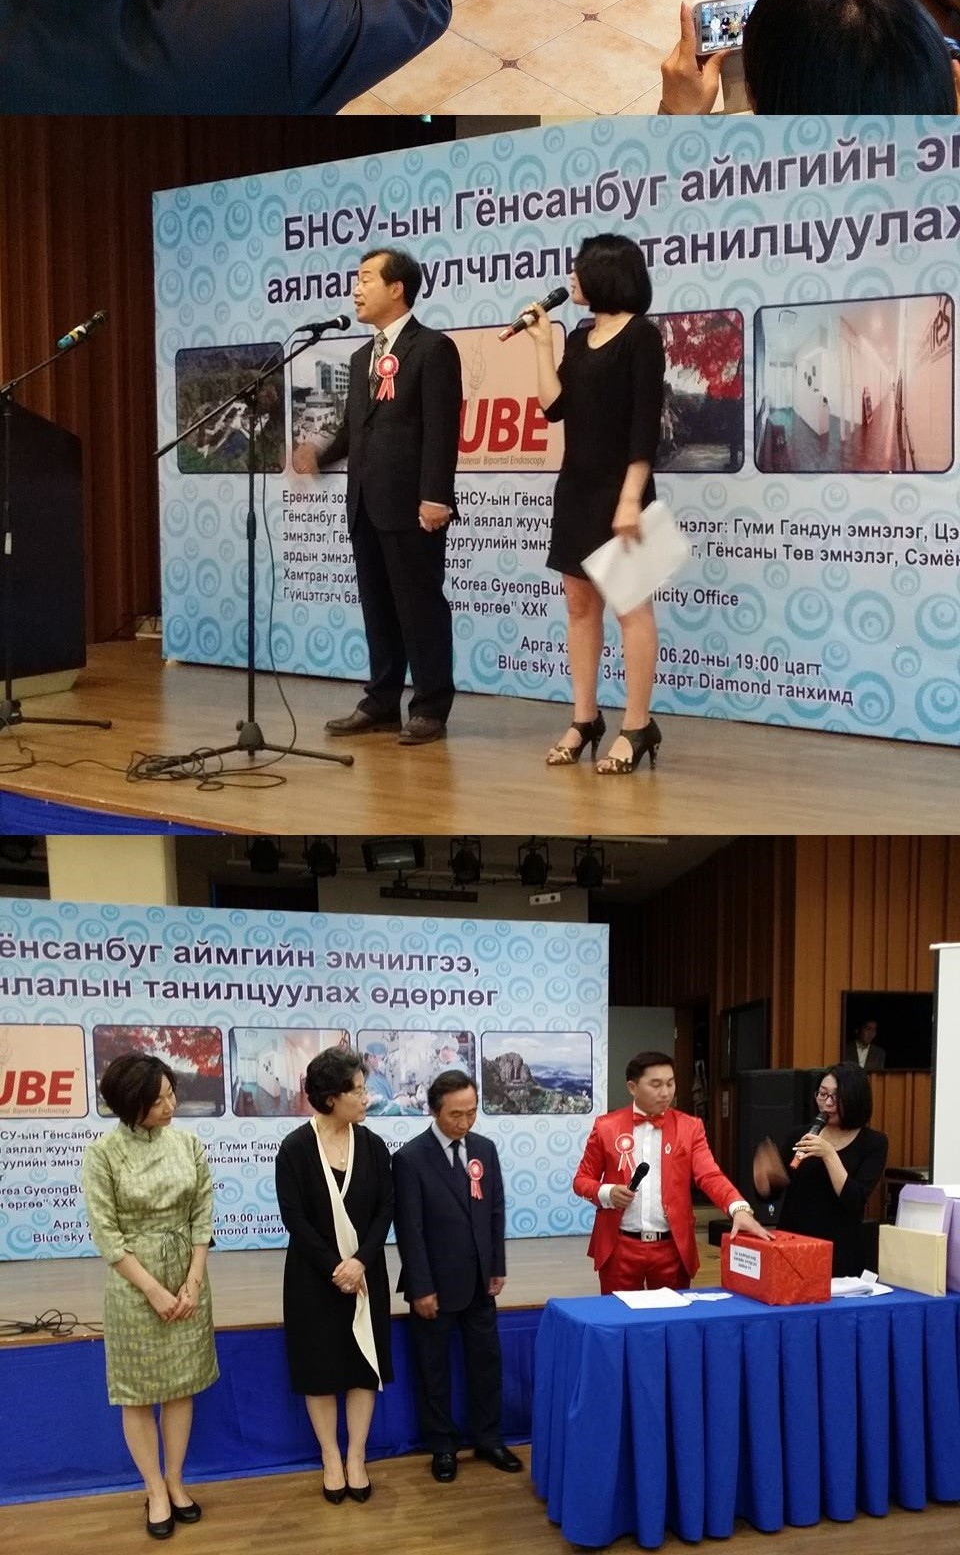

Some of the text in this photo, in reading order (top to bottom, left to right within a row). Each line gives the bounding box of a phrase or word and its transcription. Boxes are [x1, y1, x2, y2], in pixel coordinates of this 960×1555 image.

[284, 204, 441, 251] БНСУ-ын
[454, 168, 667, 230] Гёнсанбуг
[680, 136, 896, 202] аймгийн
[458, 396, 549, 453] UBE
[510, 456, 546, 466] Endoscopy
[282, 490, 328, 506] Ерөнхий
[514, 491, 553, 507] Гёнса
[283, 509, 928, 542] Гёнсанбуг аялал нэлэг: Гүми Гандун эмнэлэг,
[283, 531, 329, 545] эмнэлэг,
[707, 541, 777, 559] Гёнсаны
[783, 544, 814, 561] Төв
[820, 549, 898, 567] эмнэлэг,
[283, 551, 318, 563] ардын
[284, 568, 329, 584] Хамтран
[451, 576, 487, 591] Korea
[650, 587, 688, 607] licity
[693, 588, 739, 607] Office
[283, 587, 341, 603] Гүйцэтгэгч
[521, 601, 548, 617] ХХК
[520, 636, 553, 654] Арга
[736, 653, 779, 672] 19:00
[785, 661, 822, 676] цагт
[498, 655, 854, 706] Blue sky Diamond танхимд
[173, 940, 315, 968] аймгийн
[326, 950, 479, 977] эмчилгээ,
[143, 979, 361, 1008] танилцуулах
[371, 987, 498, 1011] өдөрлөг
[6, 1140, 247, 1154] аялал Гүми
[43, 1129, 104, 1143] Гёнсанбуг
[253, 1154, 275, 1164] Төв
[24, 1184, 83, 1198] GyeongBu
[53, 1198, 76, 1208] ХХК
[53, 1220, 82, 1231] Арга
[223, 1213, 253, 1223] 19:00
[33, 1233, 85, 1244] Blue sky
